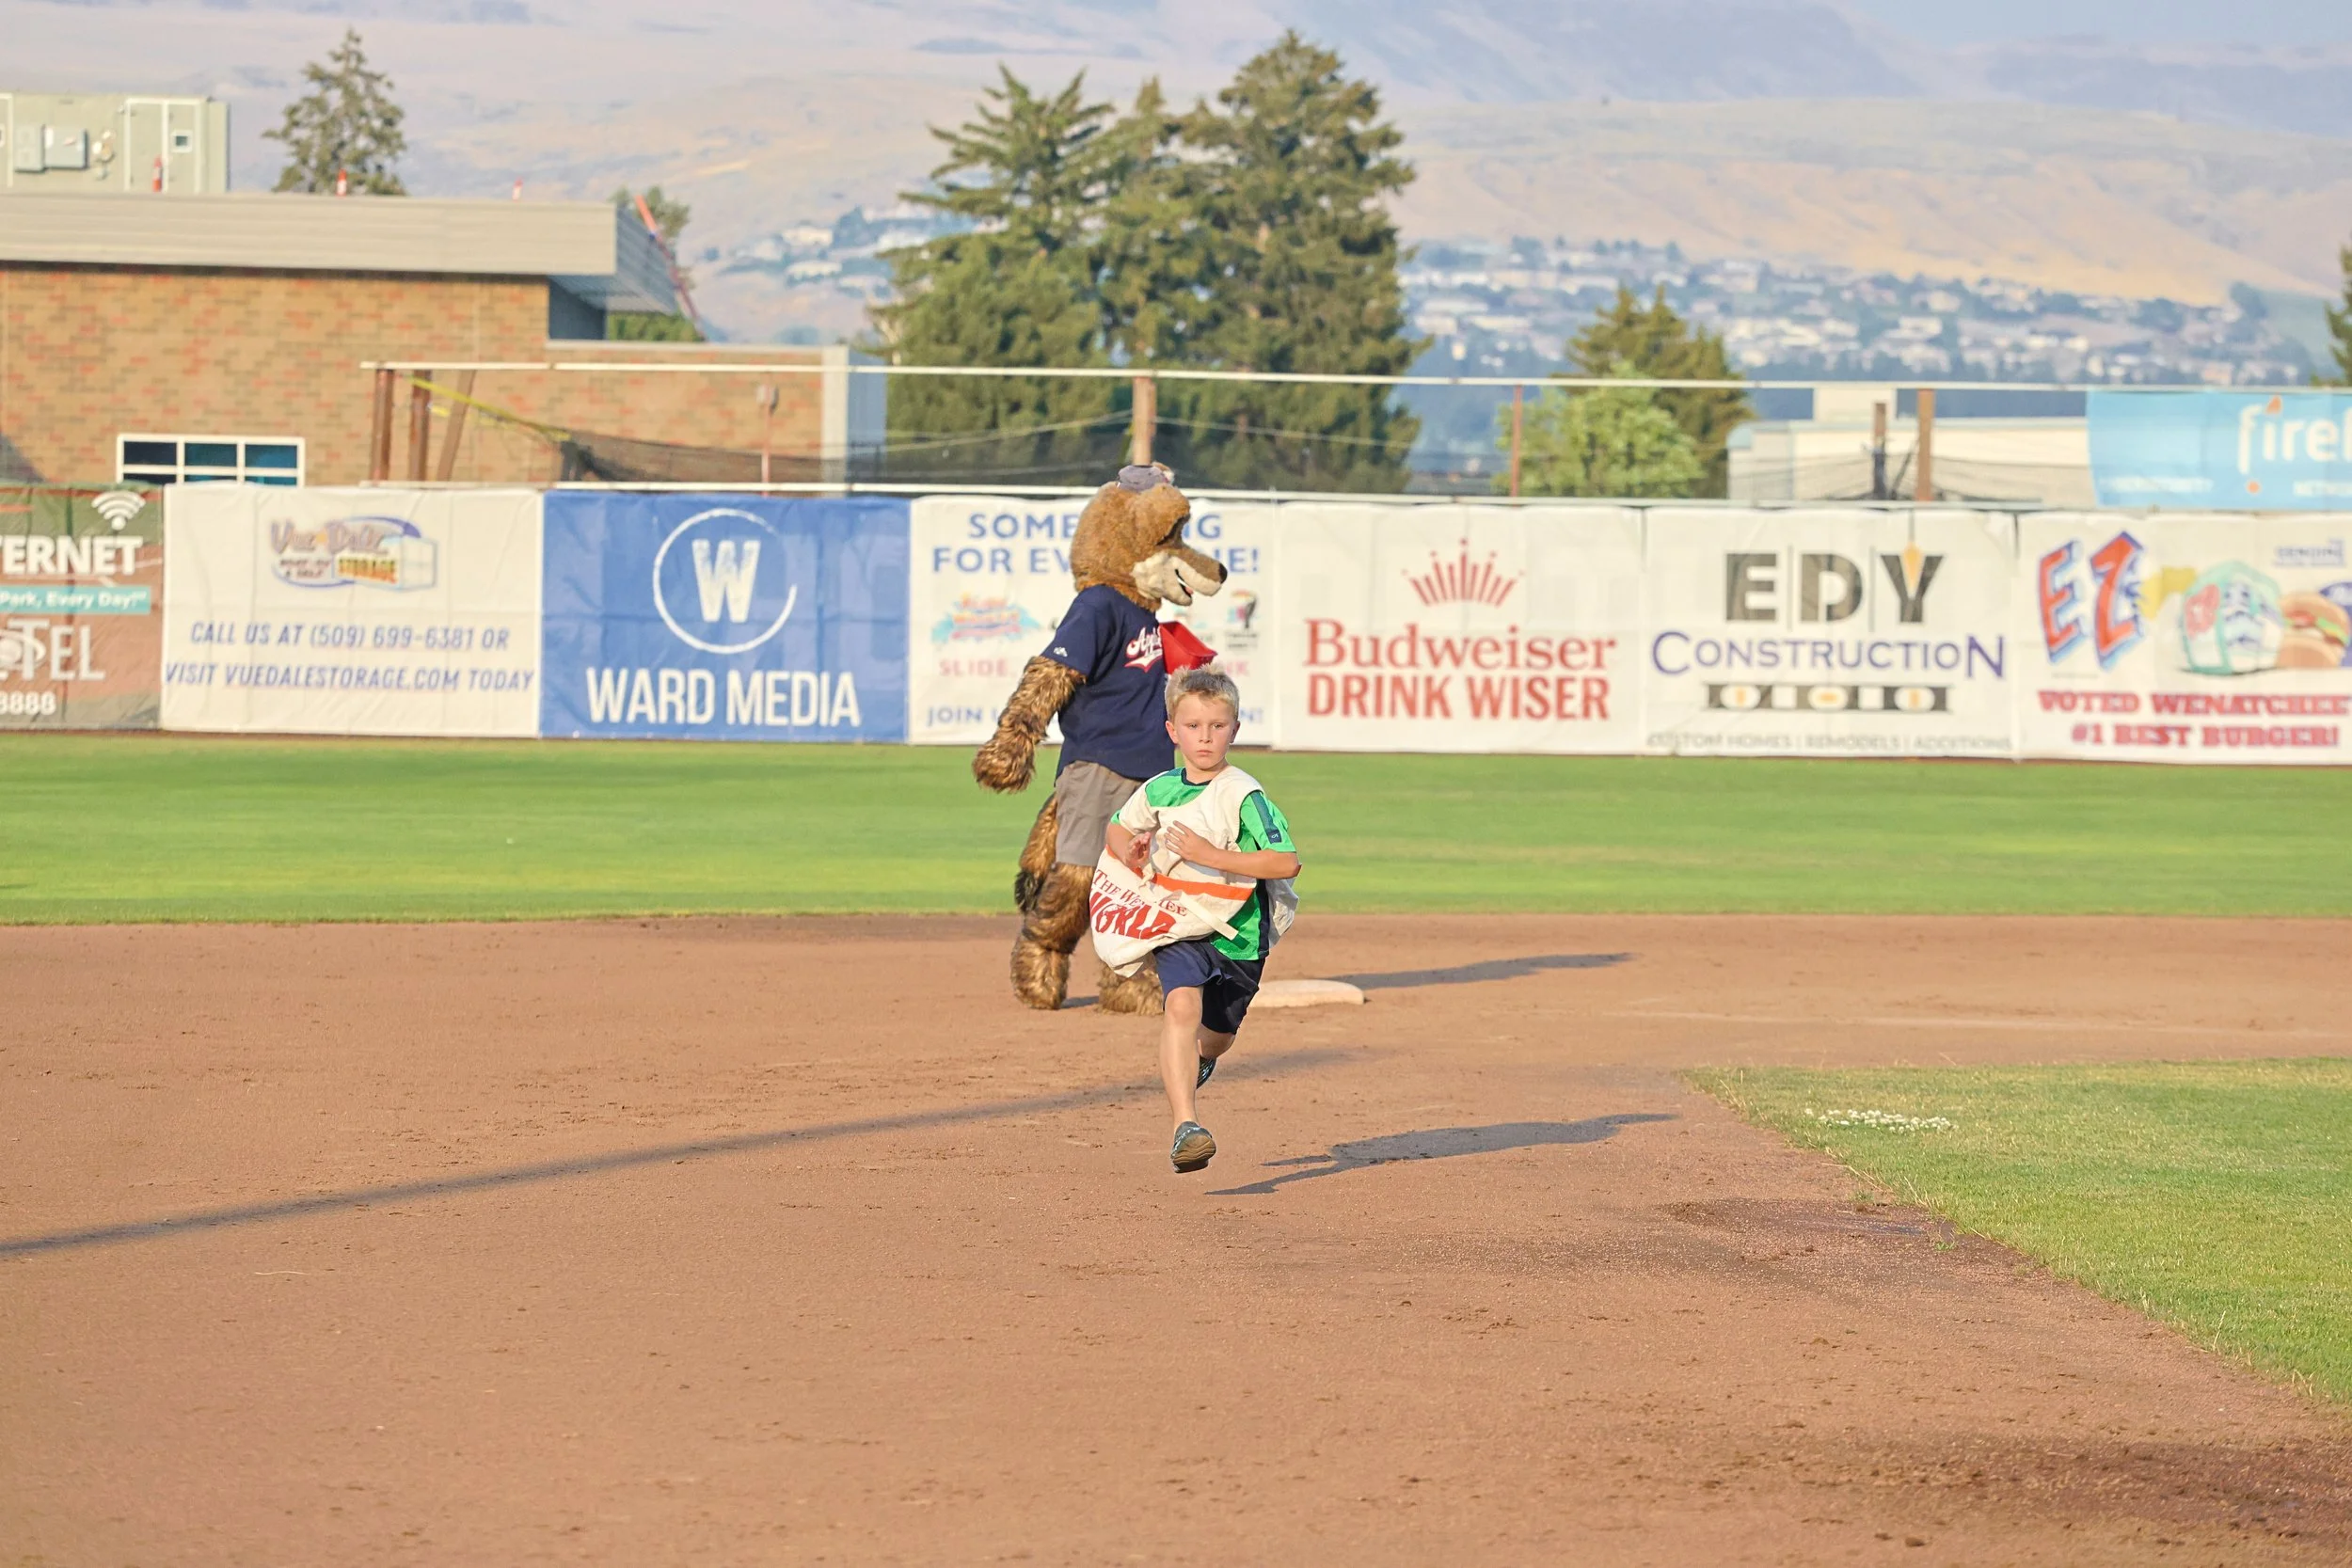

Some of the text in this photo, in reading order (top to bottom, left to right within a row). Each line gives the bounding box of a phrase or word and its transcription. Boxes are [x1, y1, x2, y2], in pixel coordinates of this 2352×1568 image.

[968, 514, 1221, 540] SOMEG
[0, 535, 143, 576] ERNET
[932, 547, 1012, 573] FOR
[691, 540, 760, 623] W
[48, 592, 94, 610] Every
[0, 618, 106, 681] TEL
[191, 621, 511, 650] CALL US AT (509) 699-6381 OR
[1303, 618, 1617, 670] Budweiser
[165, 661, 535, 691] VISIT VUEDALESTORAGE.COM TODAY
[585, 667, 862, 727] WARD MEDIA
[1308, 675, 1611, 720] DRINK WISER
[2038, 690, 2140, 712] VOTED
[928, 706, 983, 727] JOIN
[2113, 724, 2191, 746] BEST
[2202, 726, 2339, 747] BURGER!
